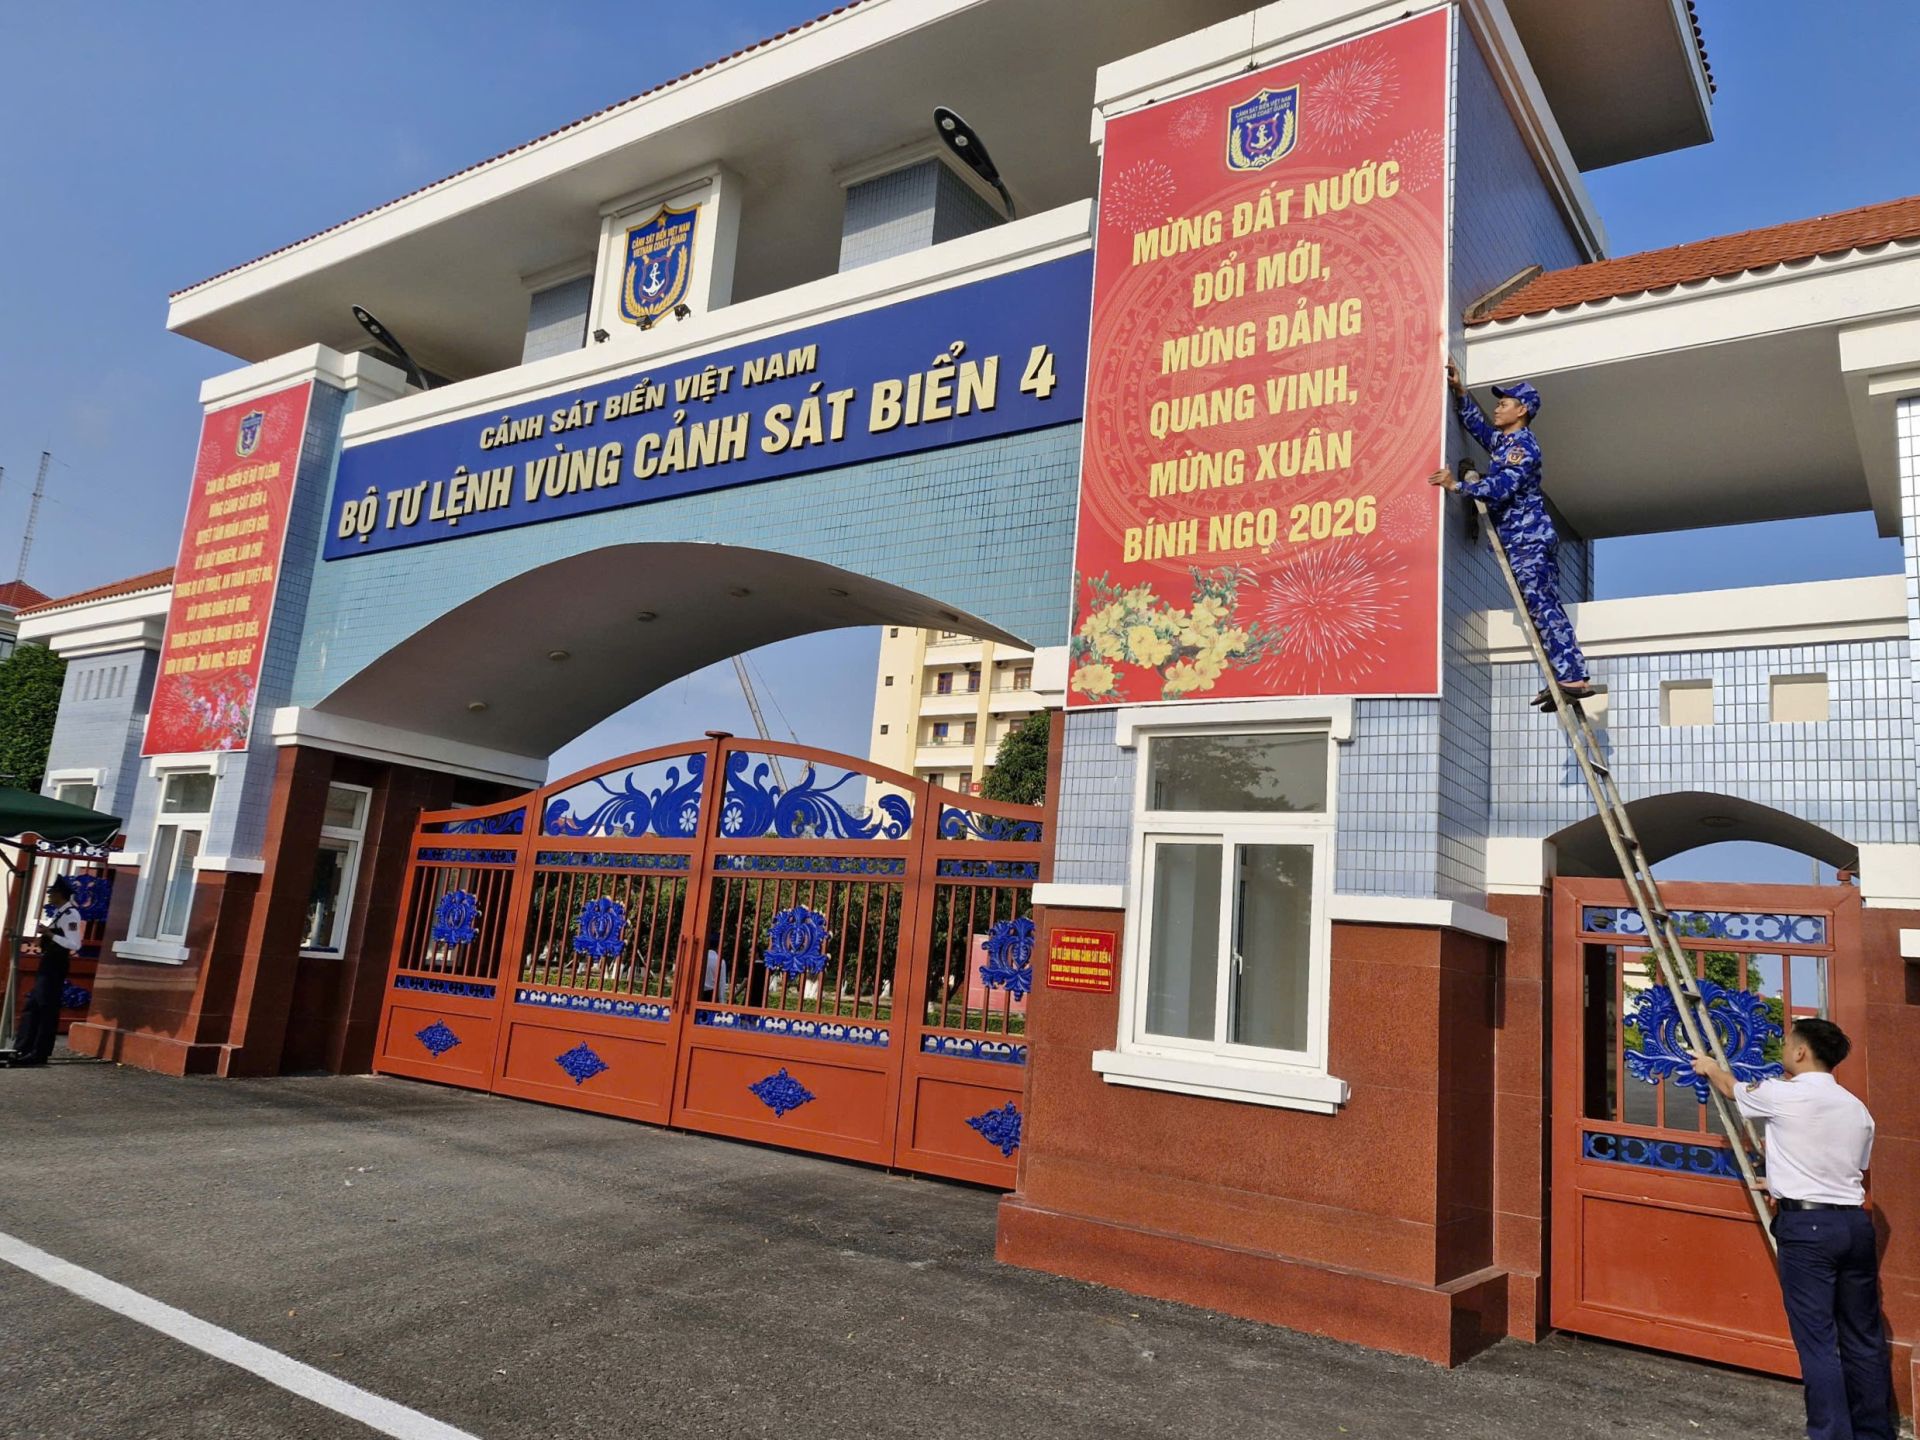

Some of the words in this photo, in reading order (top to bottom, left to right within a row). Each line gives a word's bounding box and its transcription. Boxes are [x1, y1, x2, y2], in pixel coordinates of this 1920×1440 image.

[1257, 108, 1273, 118] COAST
[633, 243, 653, 258] VIETNAM
[654, 239, 670, 251] COAST
[1132, 209, 1224, 266] MỪNG
[1232, 181, 1295, 238] ĐẤT
[1303, 159, 1401, 219] NƯỚC
[1193, 251, 1246, 308] ĐỔI
[1256, 239, 1330, 294] MỚI,
[1161, 321, 1256, 375] MỪNG
[1266, 297, 1362, 353] ĐẢNG
[480, 415, 544, 450] CẢNH
[549, 400, 598, 433] SÁT
[604, 377, 667, 421] BIỂN
[675, 364, 734, 402] VIỆT
[741, 344, 818, 386] NAM
[1149, 383, 1255, 440] QUANG
[1266, 365, 1358, 416] VINH,
[338, 486, 379, 543] BỘ
[385, 480, 428, 529] TƯ
[429, 464, 514, 526] LỆNH
[524, 443, 623, 502] VÙNG
[633, 409, 750, 479] CẢNH
[761, 381, 855, 454] SÁT
[868, 340, 999, 433] BIỂN
[1020, 344, 1057, 398] 4
[1149, 448, 1246, 499] MỪNG
[1255, 427, 1353, 482] XUÂN
[1123, 515, 1198, 564] BÍNH
[1208, 507, 1278, 555] NGỌ
[1287, 494, 1378, 542] 2026
